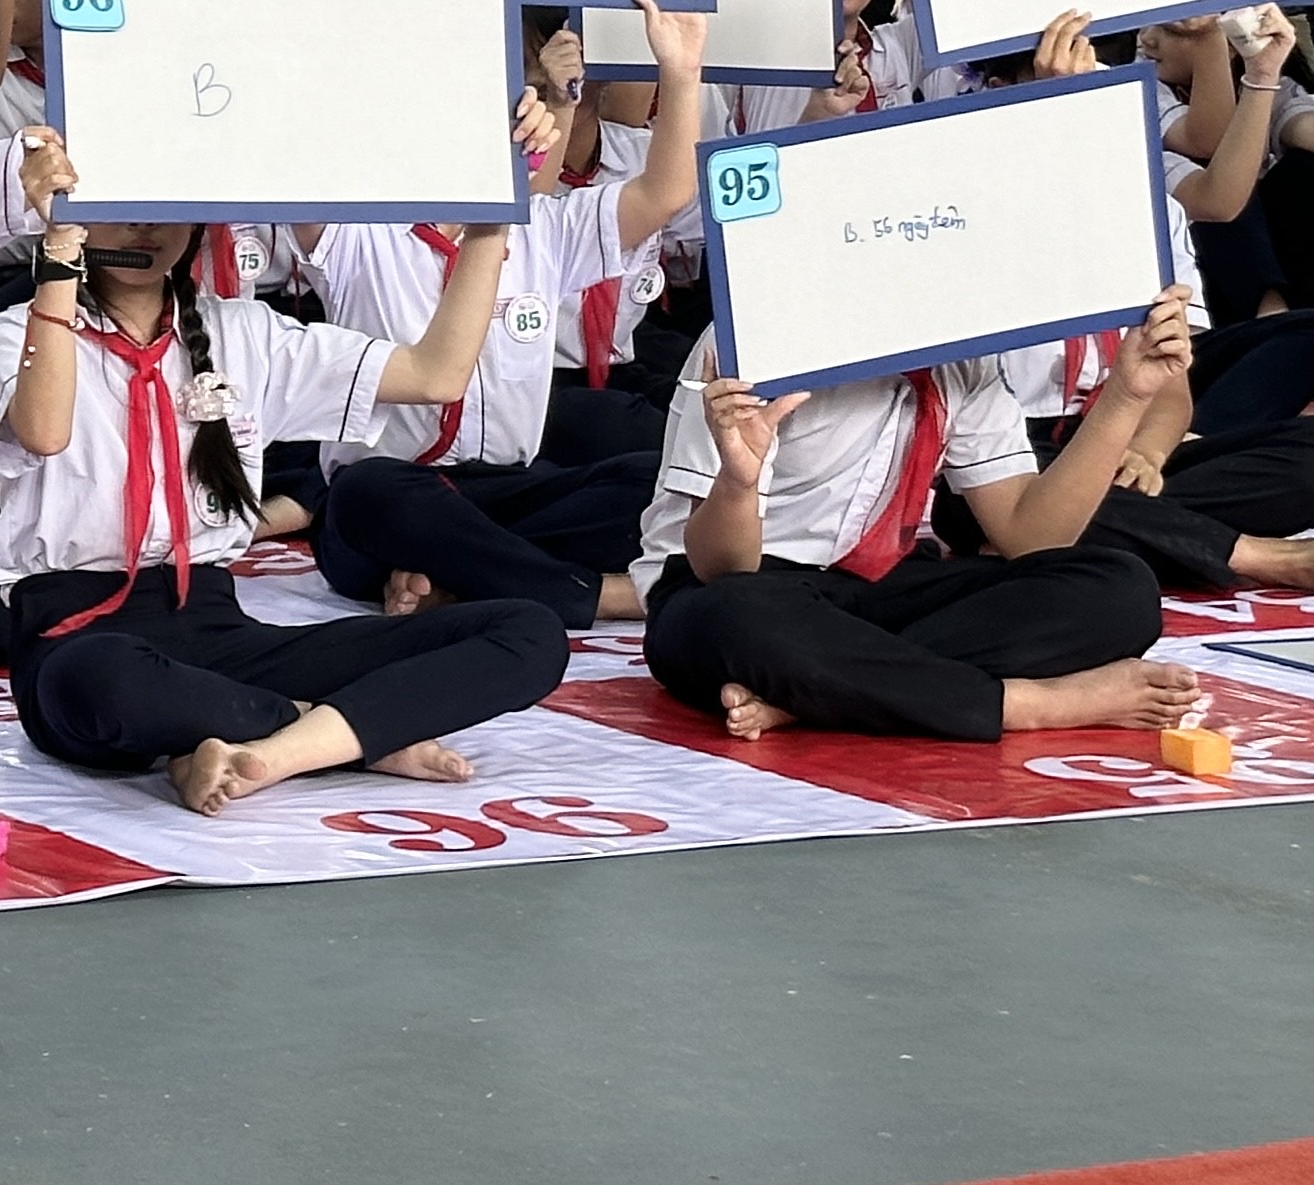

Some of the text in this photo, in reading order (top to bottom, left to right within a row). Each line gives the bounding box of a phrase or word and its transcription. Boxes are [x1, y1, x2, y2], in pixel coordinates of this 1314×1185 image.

[190, 62, 232, 117] B
[718, 161, 770, 206] 95
[872, 218, 893, 238] 56
[239, 253, 260, 271] 75
[635, 277, 655, 296] 74
[516, 310, 542, 332] 85
[320, 795, 670, 852] 96
